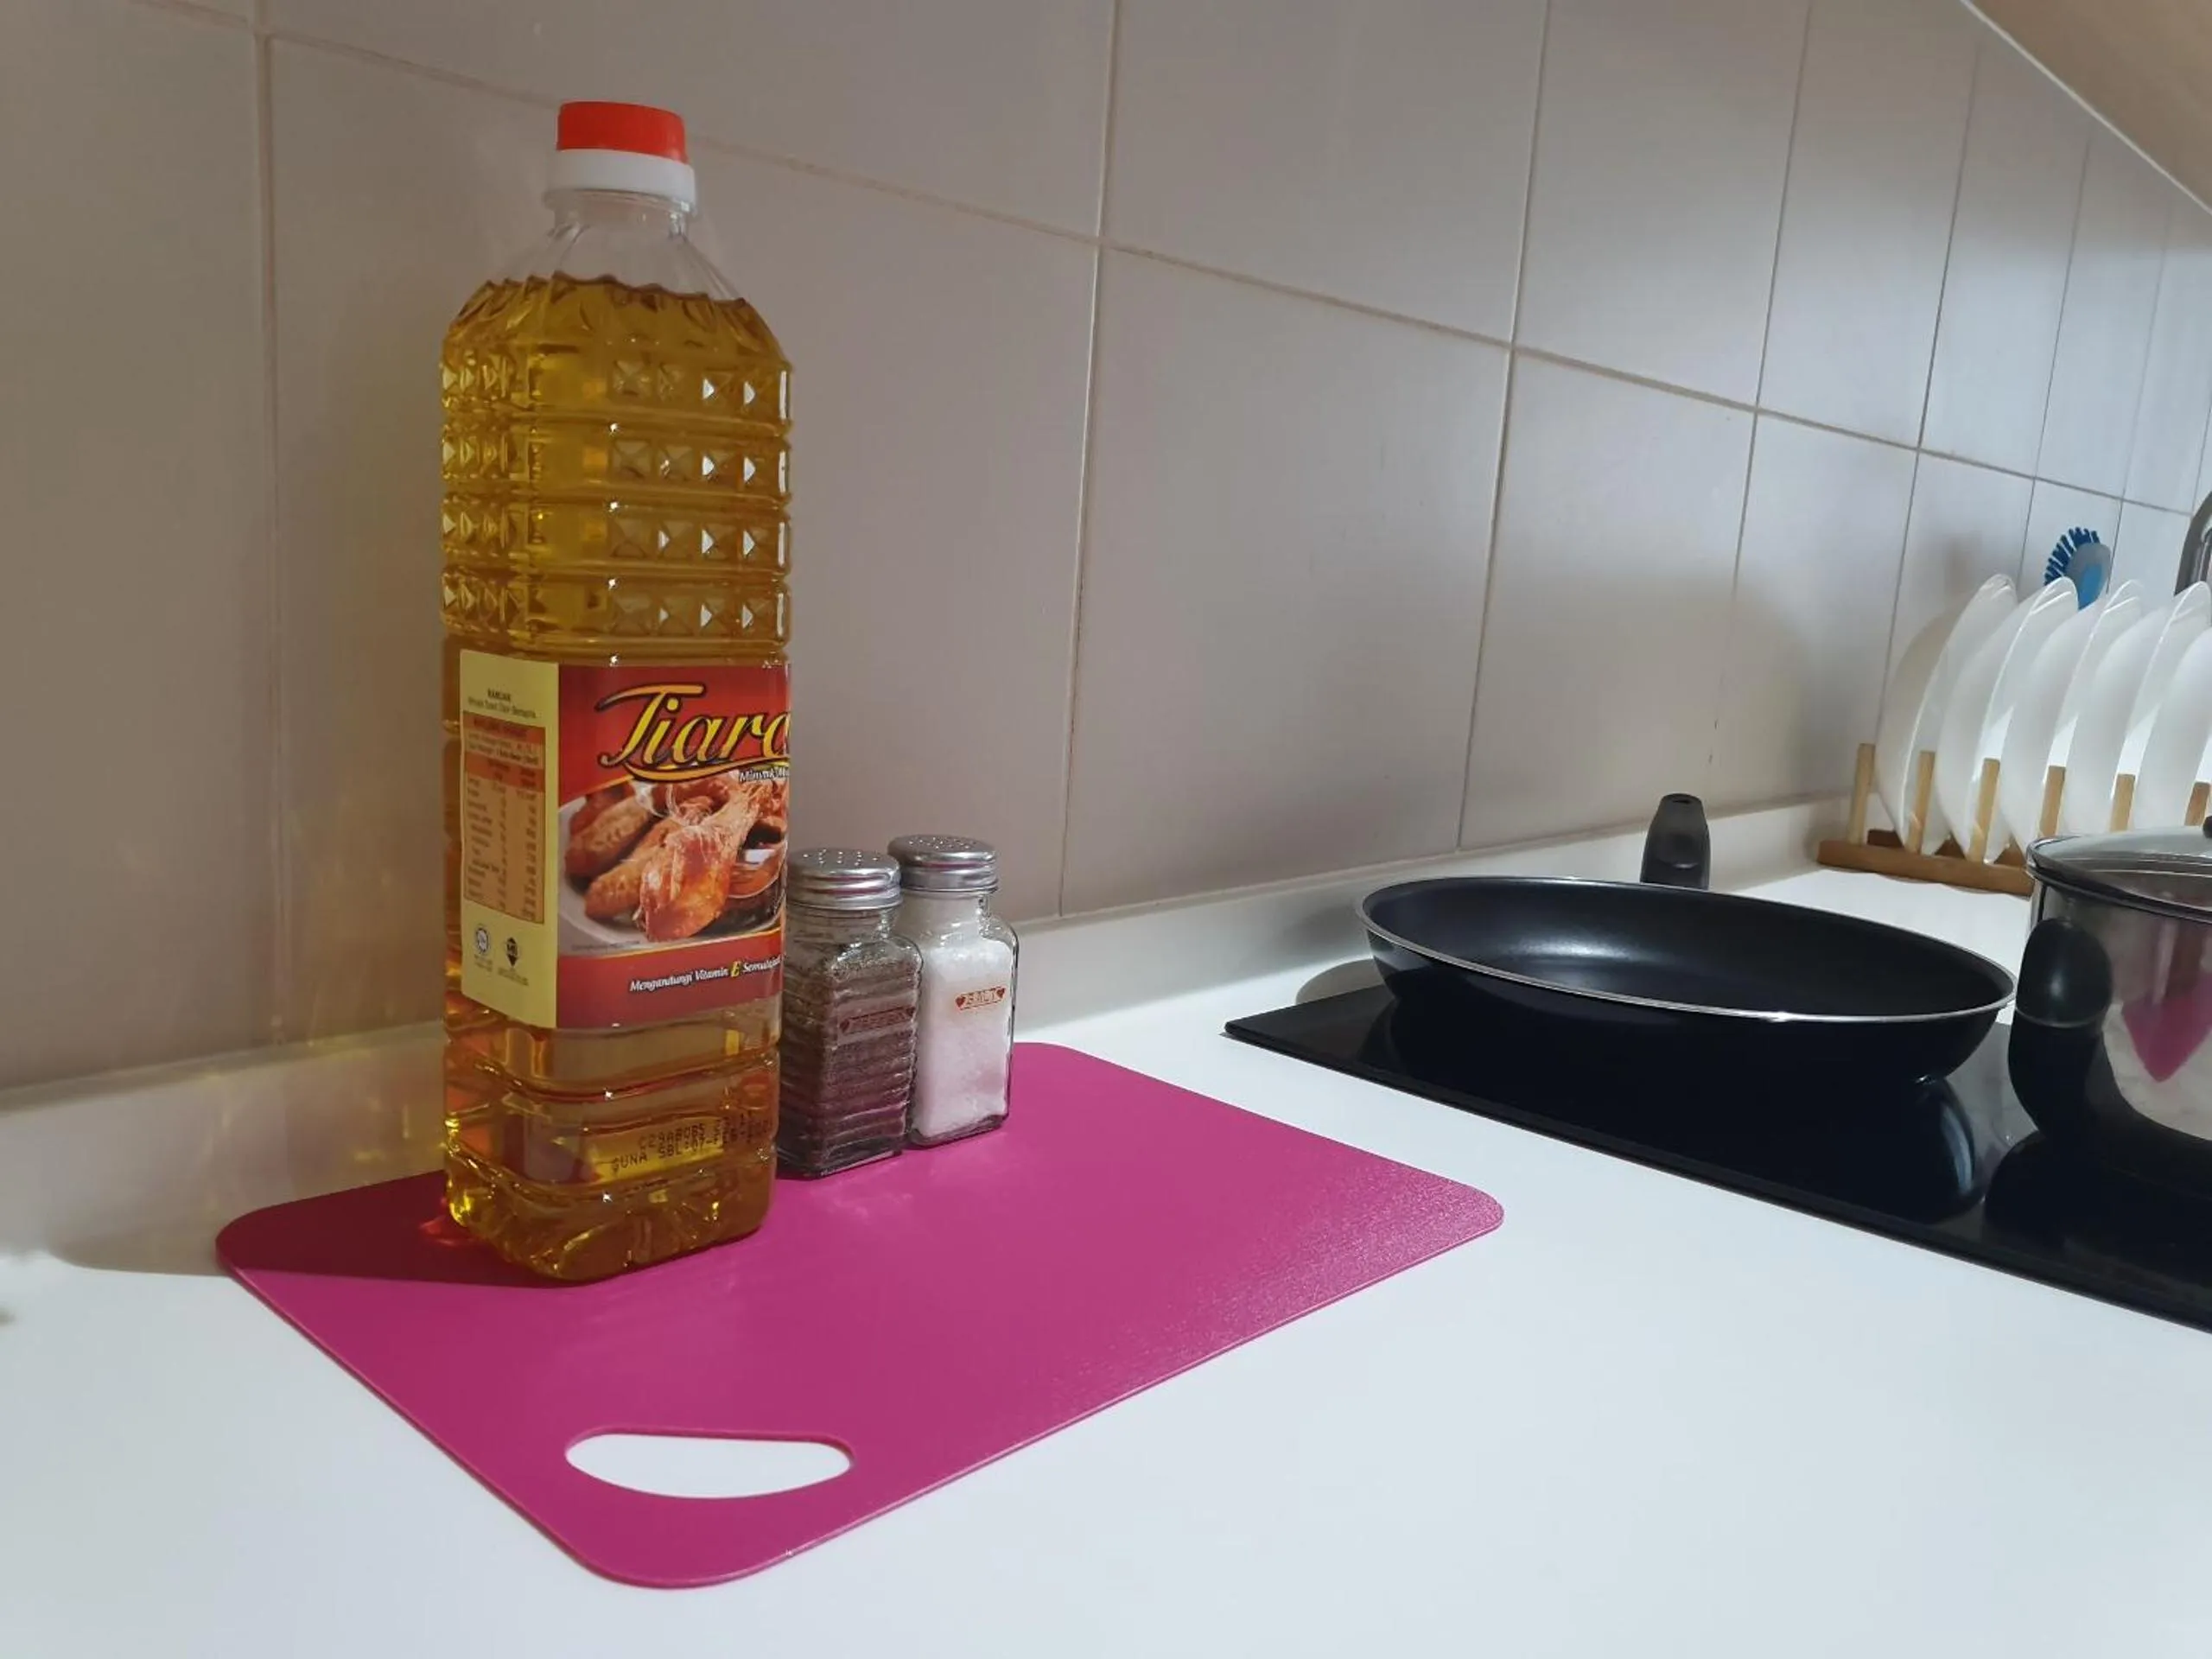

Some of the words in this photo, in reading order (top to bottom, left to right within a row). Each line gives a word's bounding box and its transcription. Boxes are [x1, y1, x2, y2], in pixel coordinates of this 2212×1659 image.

[629, 970, 693, 993] Mengandungi
[695, 966, 729, 982] Vitamin
[730, 960, 741, 978] E
